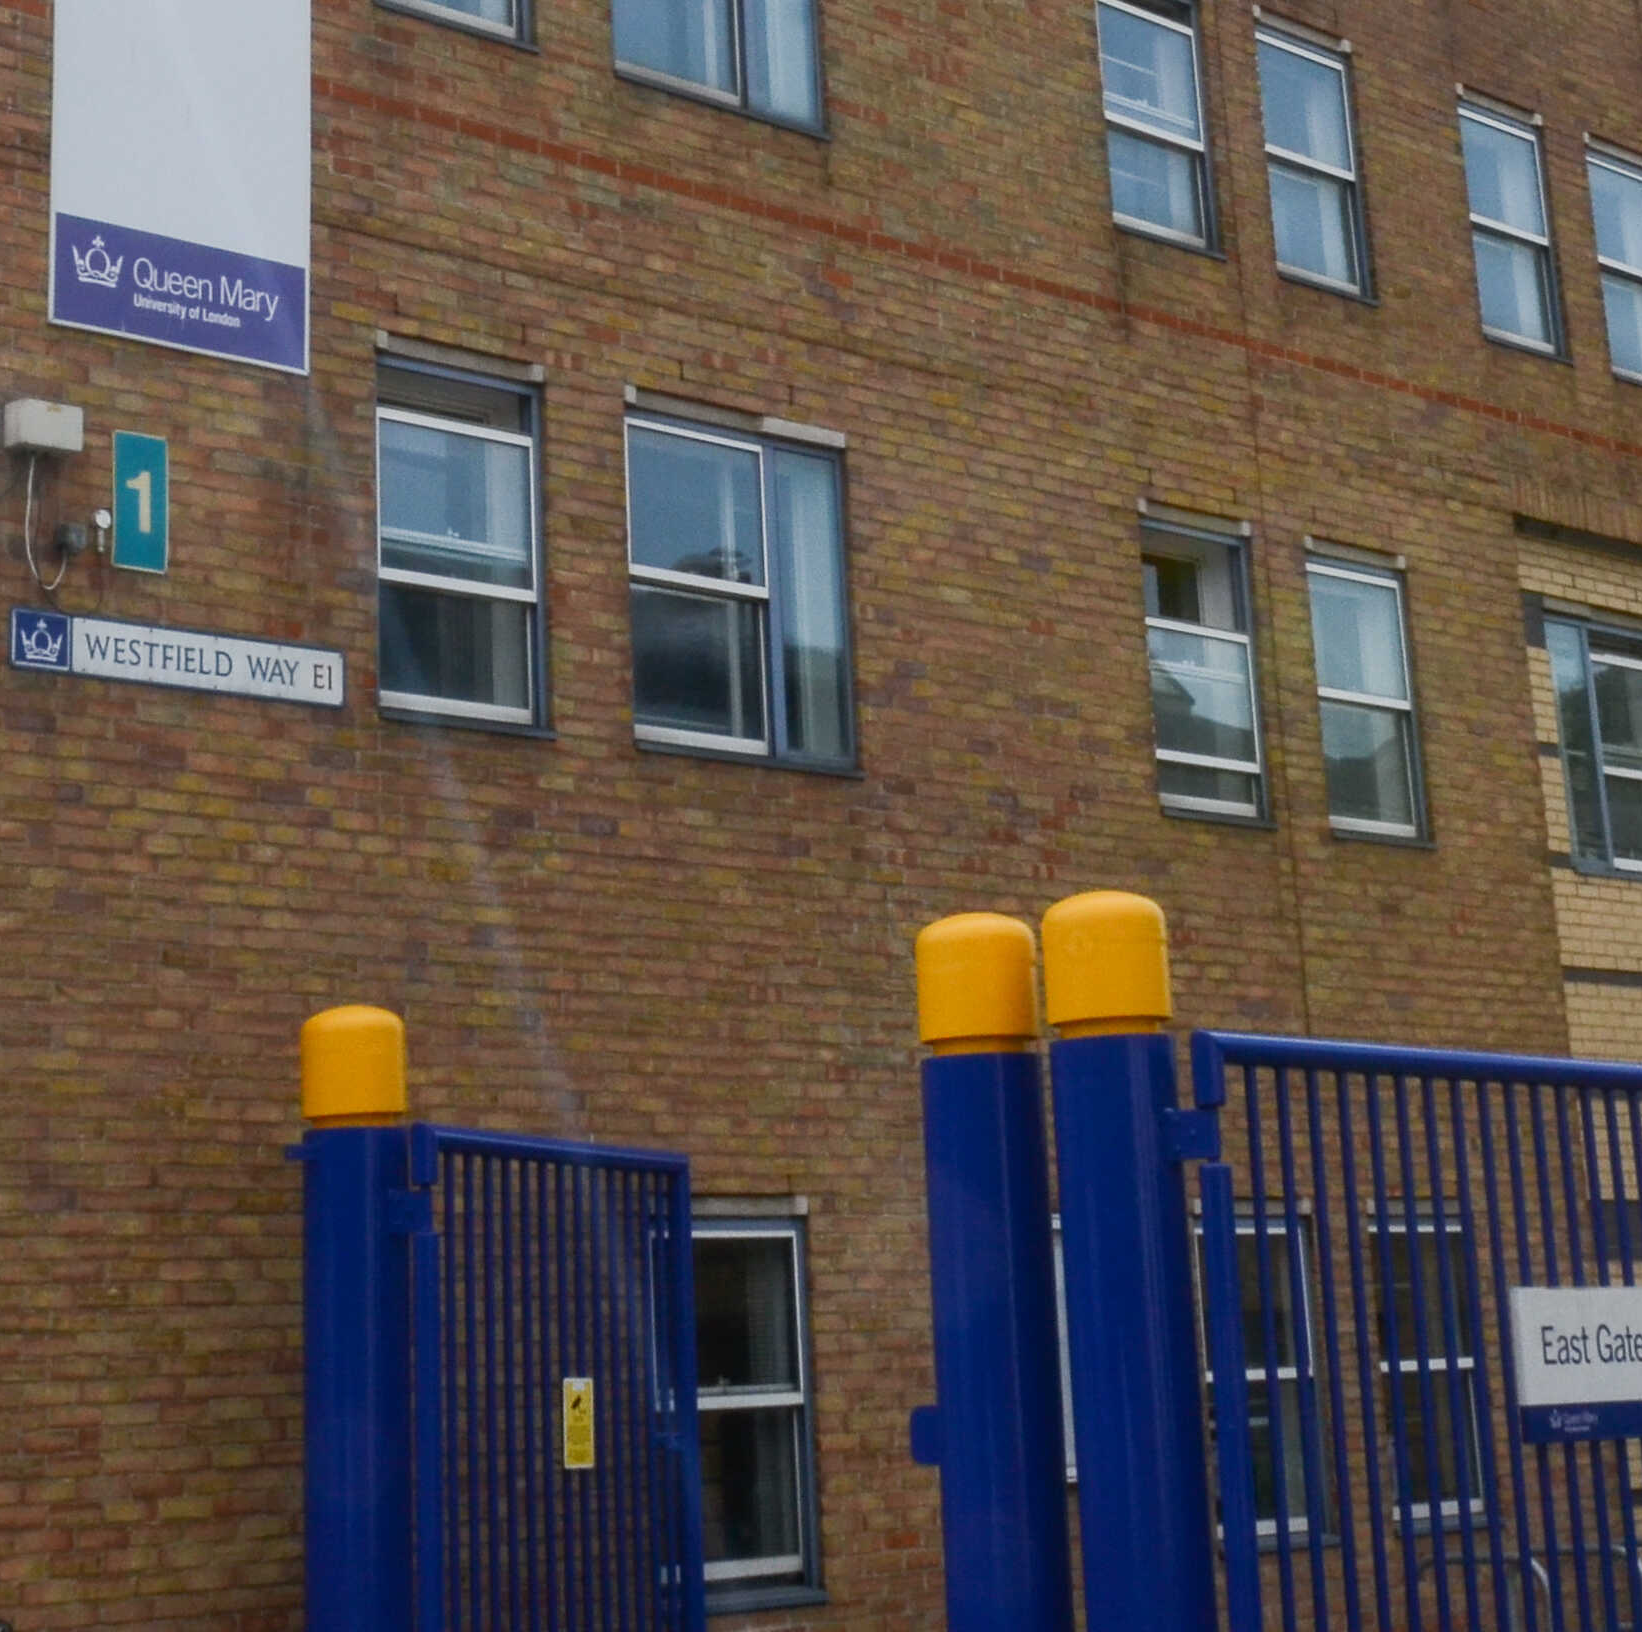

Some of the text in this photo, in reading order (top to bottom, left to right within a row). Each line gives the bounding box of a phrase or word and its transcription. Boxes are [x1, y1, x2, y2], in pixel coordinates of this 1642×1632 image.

[133, 258, 279, 321] Queen Mary
[133, 293, 241, 328] University of London
[126, 471, 152, 533] 1
[85, 634, 333, 691] WESTFIELD WAY E1
[1541, 1325, 1591, 1365] East
